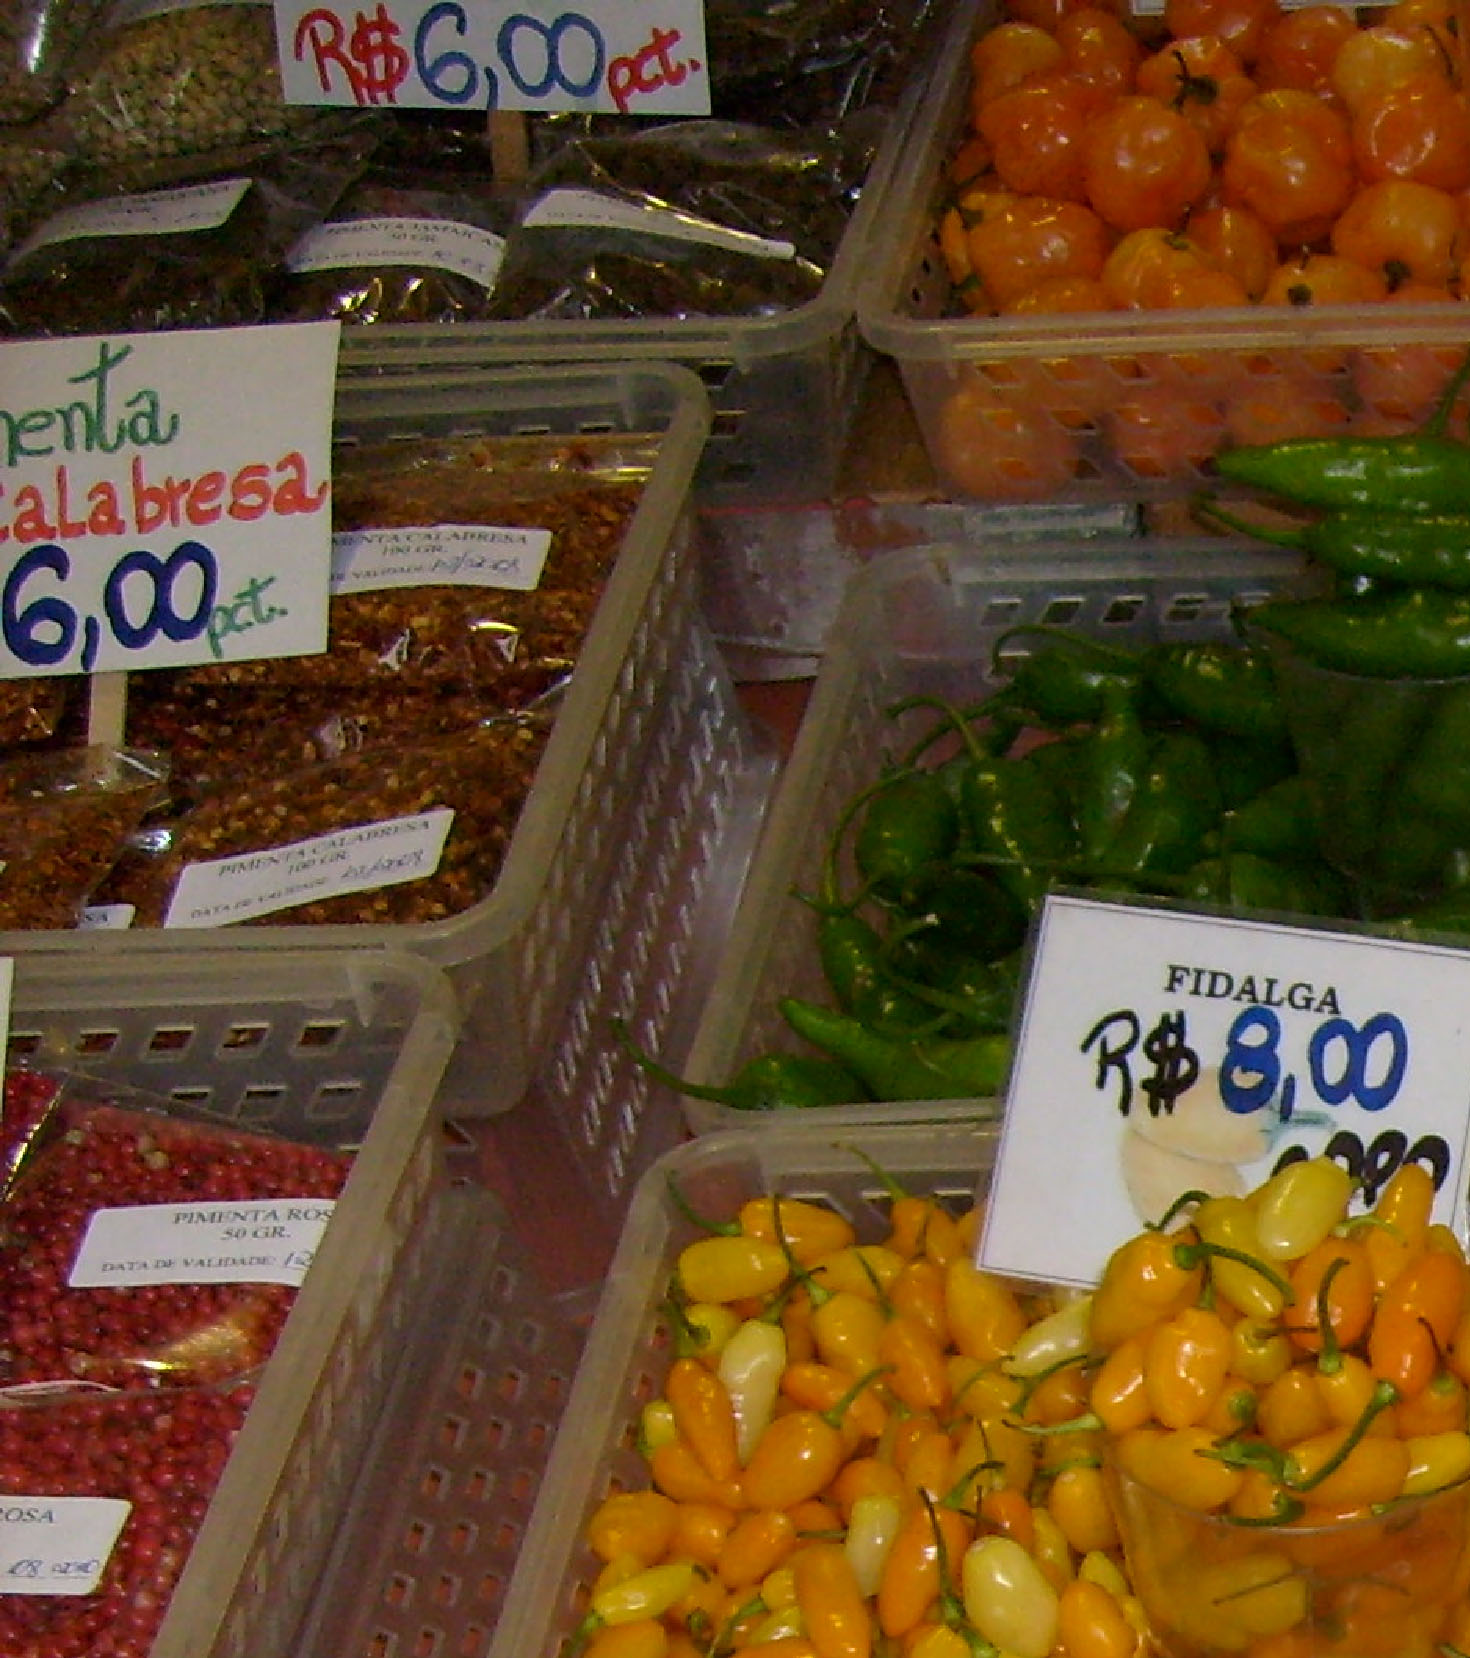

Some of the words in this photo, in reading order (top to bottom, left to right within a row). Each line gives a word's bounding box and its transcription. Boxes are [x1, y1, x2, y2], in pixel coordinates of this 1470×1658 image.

[1, 541, 219, 673] 6,00
[1164, 963, 1343, 1016] FIDALGA
[1079, 1009, 1201, 1118] R$
[1217, 1005, 1410, 1123] 8,00
[172, 1207, 280, 1225] PIMENTA
[0, 1507, 54, 1524] OSA
